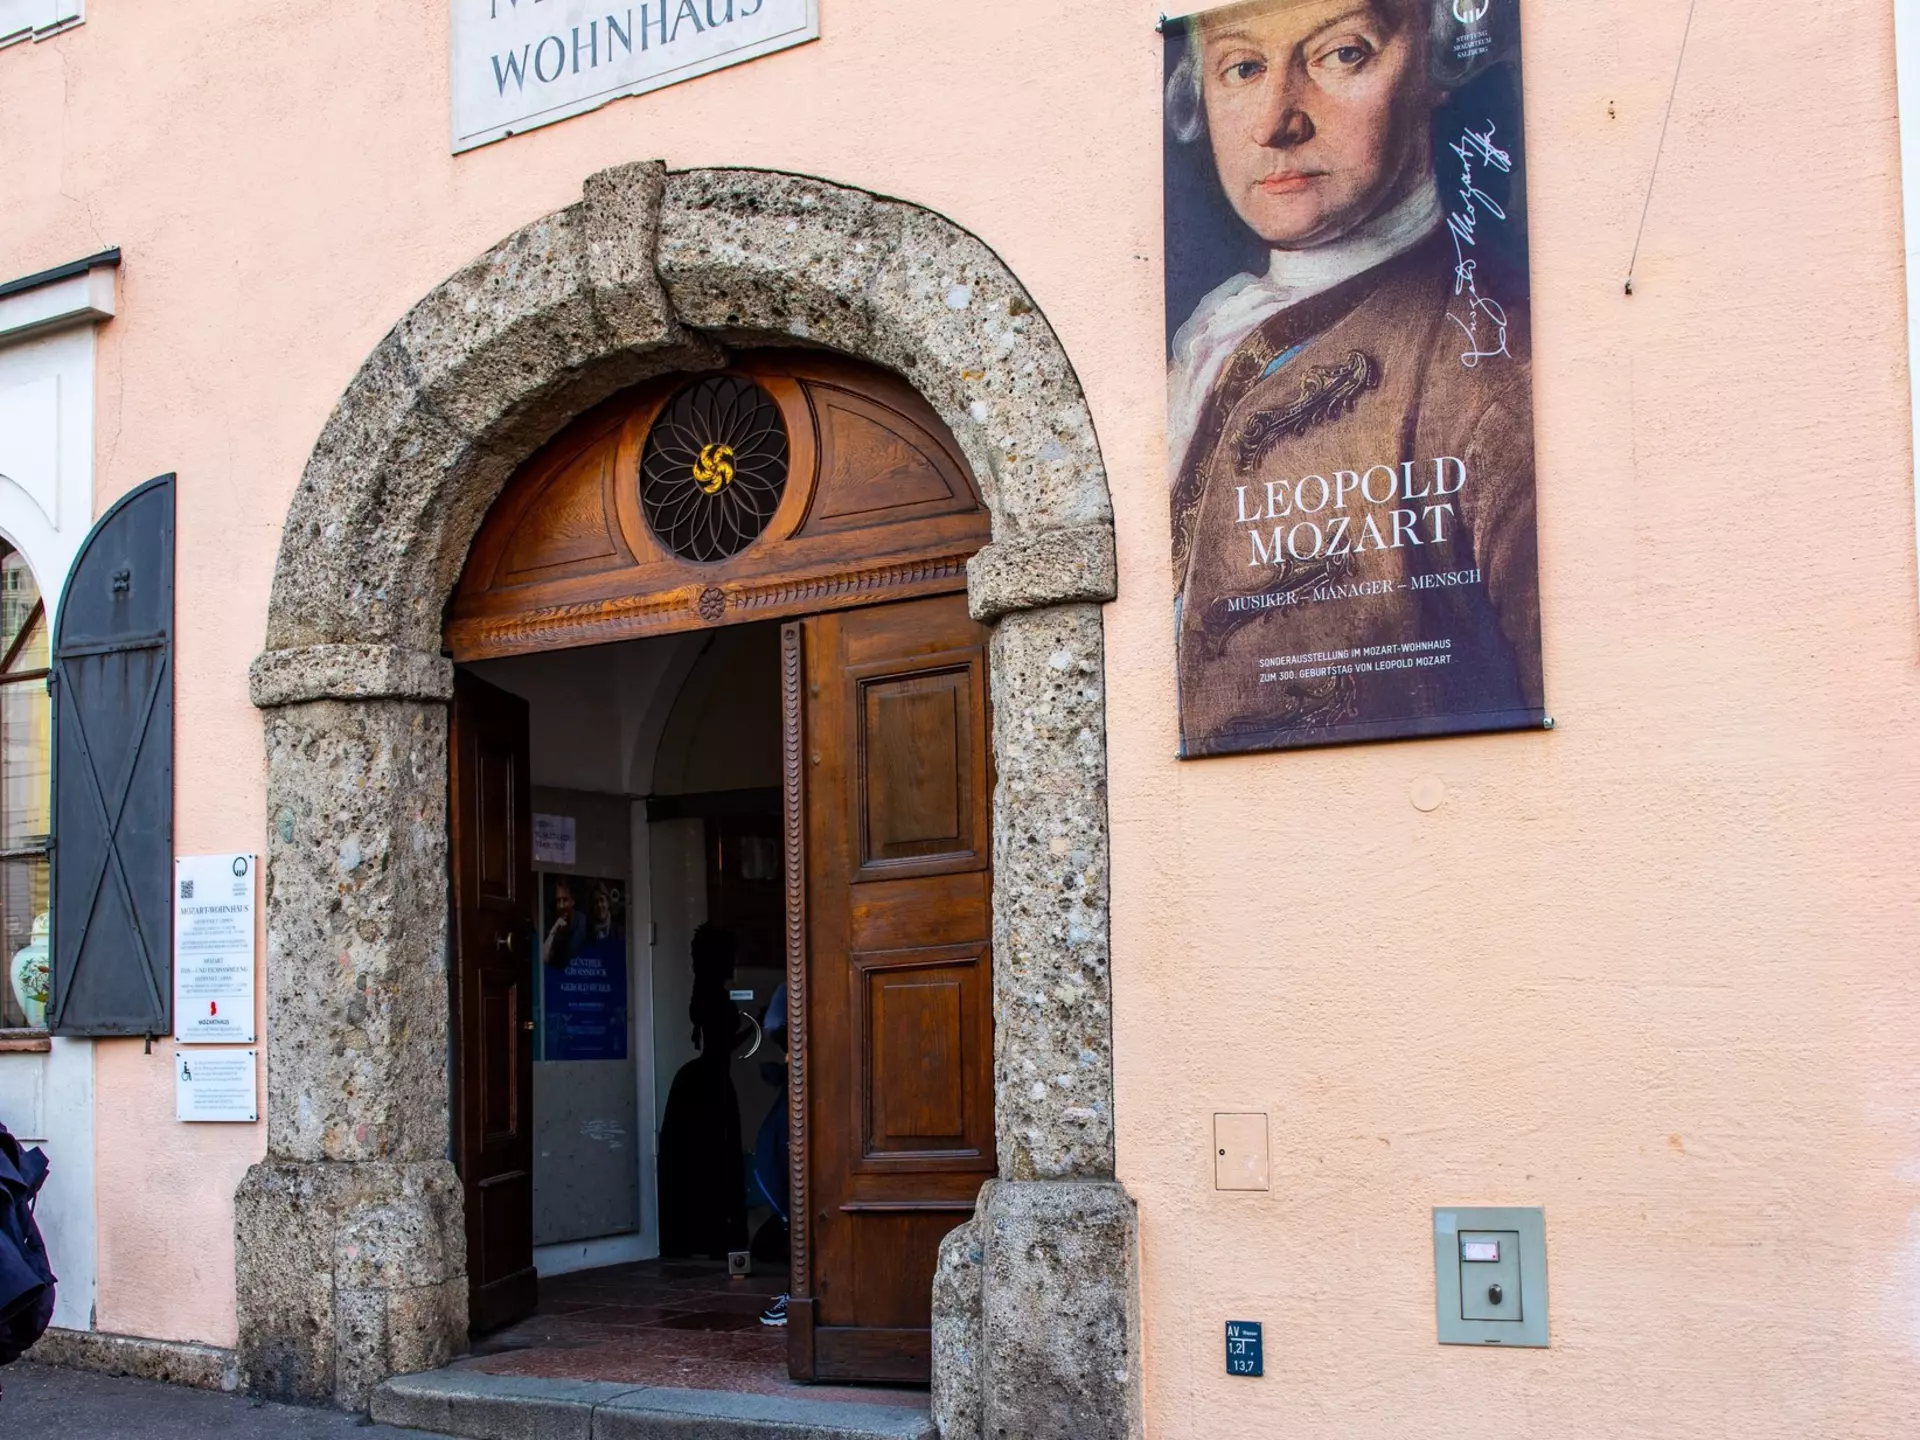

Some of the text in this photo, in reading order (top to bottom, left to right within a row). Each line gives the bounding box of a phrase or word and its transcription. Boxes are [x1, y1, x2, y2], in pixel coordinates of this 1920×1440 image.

[1235, 456, 1467, 523] LEOPOLD
[1248, 503, 1455, 566] MOZART
[1227, 589, 1297, 612] MUSIKER
[1312, 579, 1393, 602] MANAGER
[1410, 568, 1482, 591] MENSCH
[1259, 638, 1451, 668] SONDERAUSSTELLUNG IM MOZART-WOHNHAUS
[1259, 653, 1452, 683] ZUM 300. GEBURTSTAG VON LEOPOLD MOZART
[1227, 1325, 1240, 1337] AV
[1229, 1342, 1242, 1355] 1,2
[1234, 1359, 1254, 1373] 13,7
